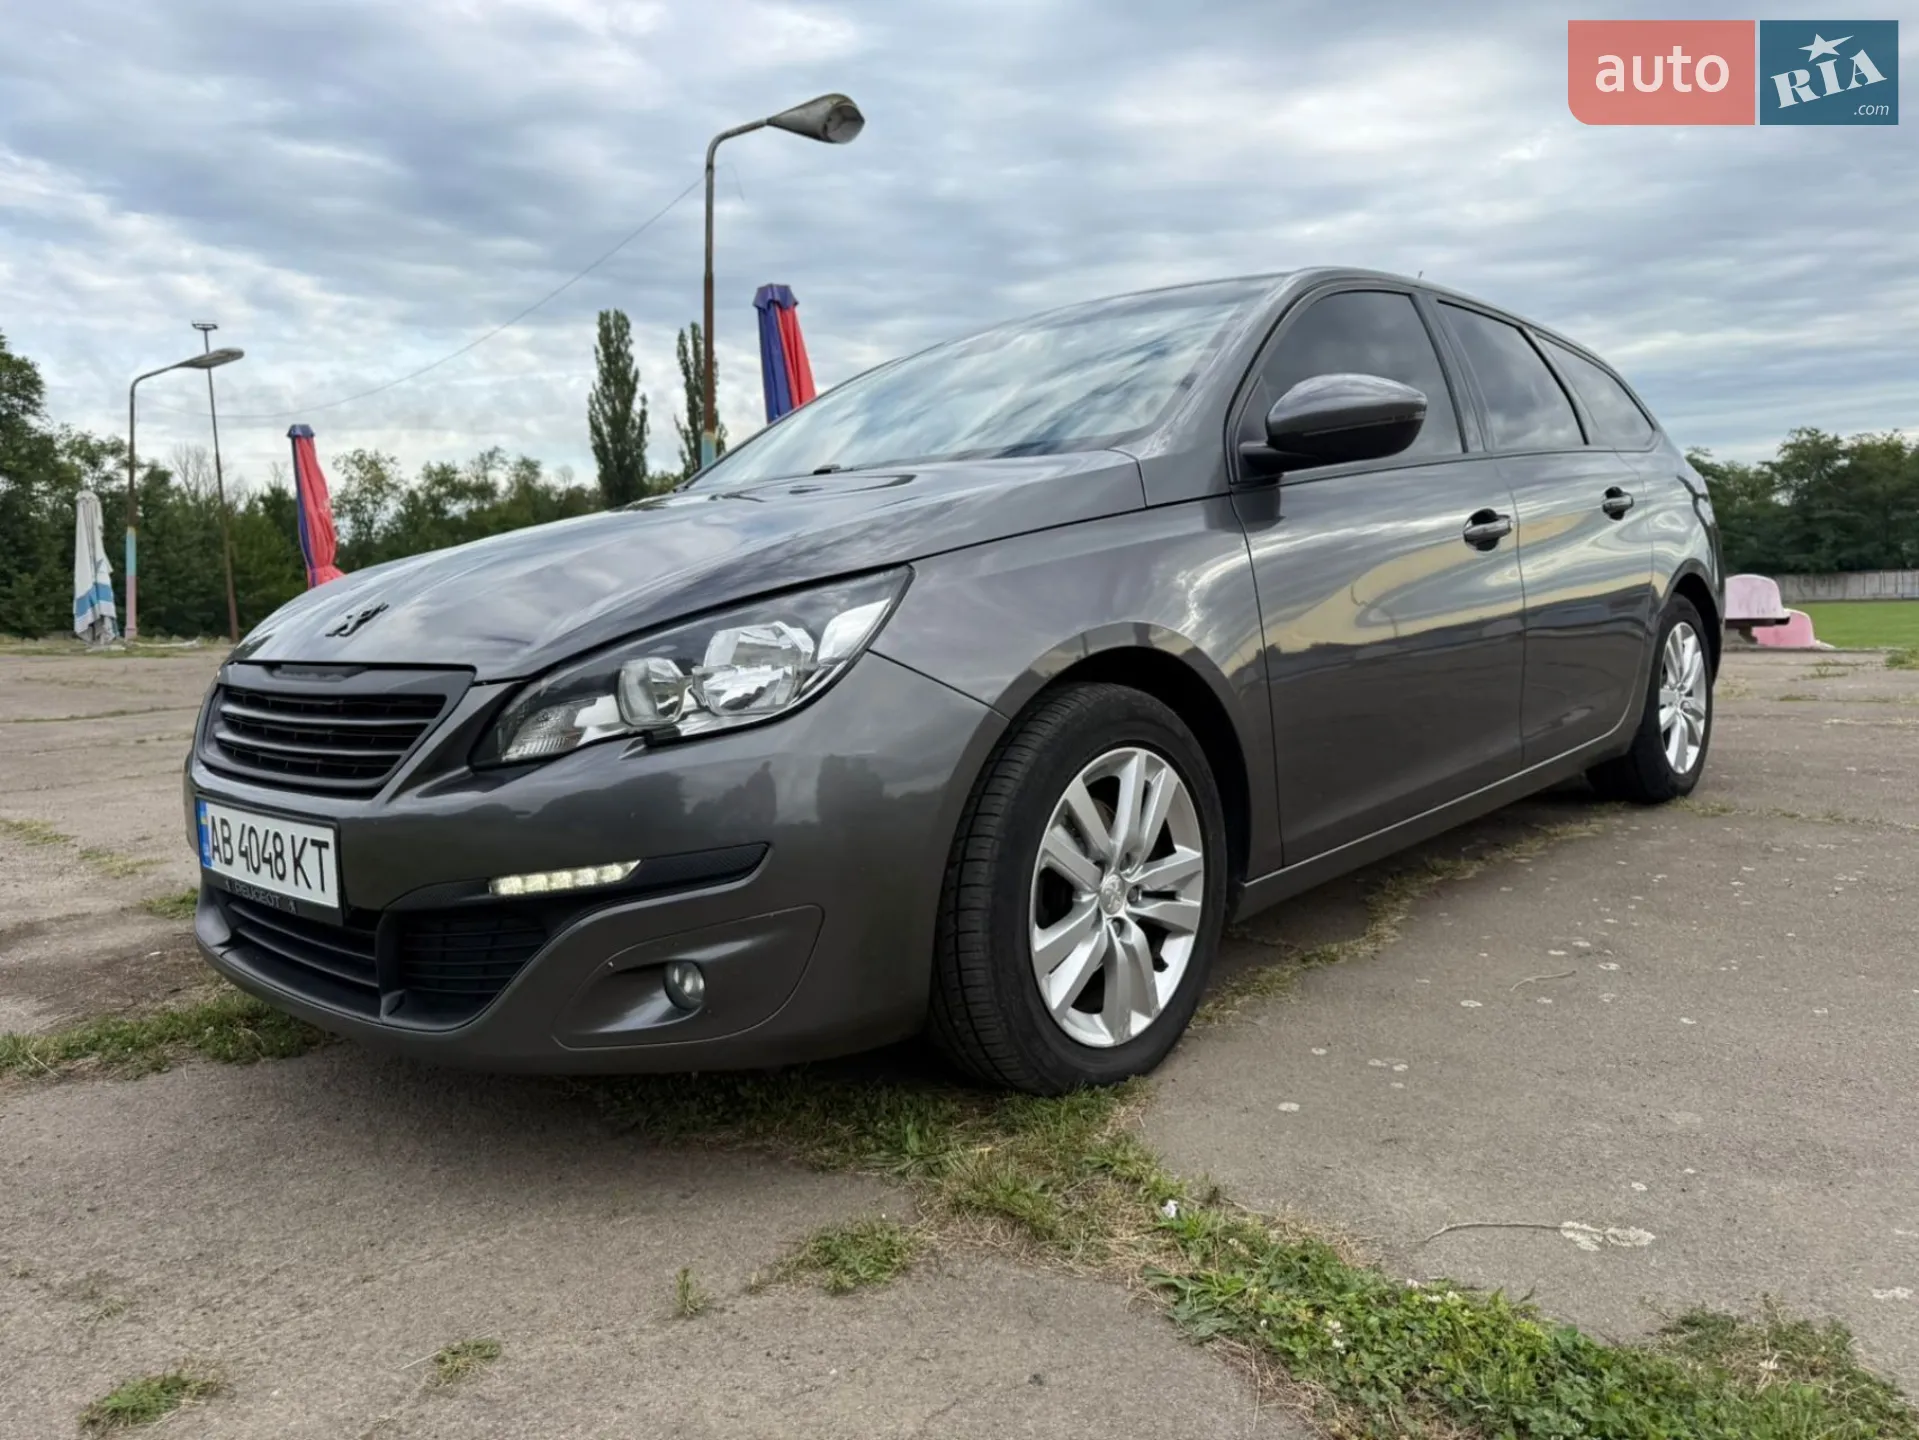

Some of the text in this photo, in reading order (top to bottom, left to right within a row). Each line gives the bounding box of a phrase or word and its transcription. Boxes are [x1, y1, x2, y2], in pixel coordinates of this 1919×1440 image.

[211, 815, 330, 893] AB 4048 KT
